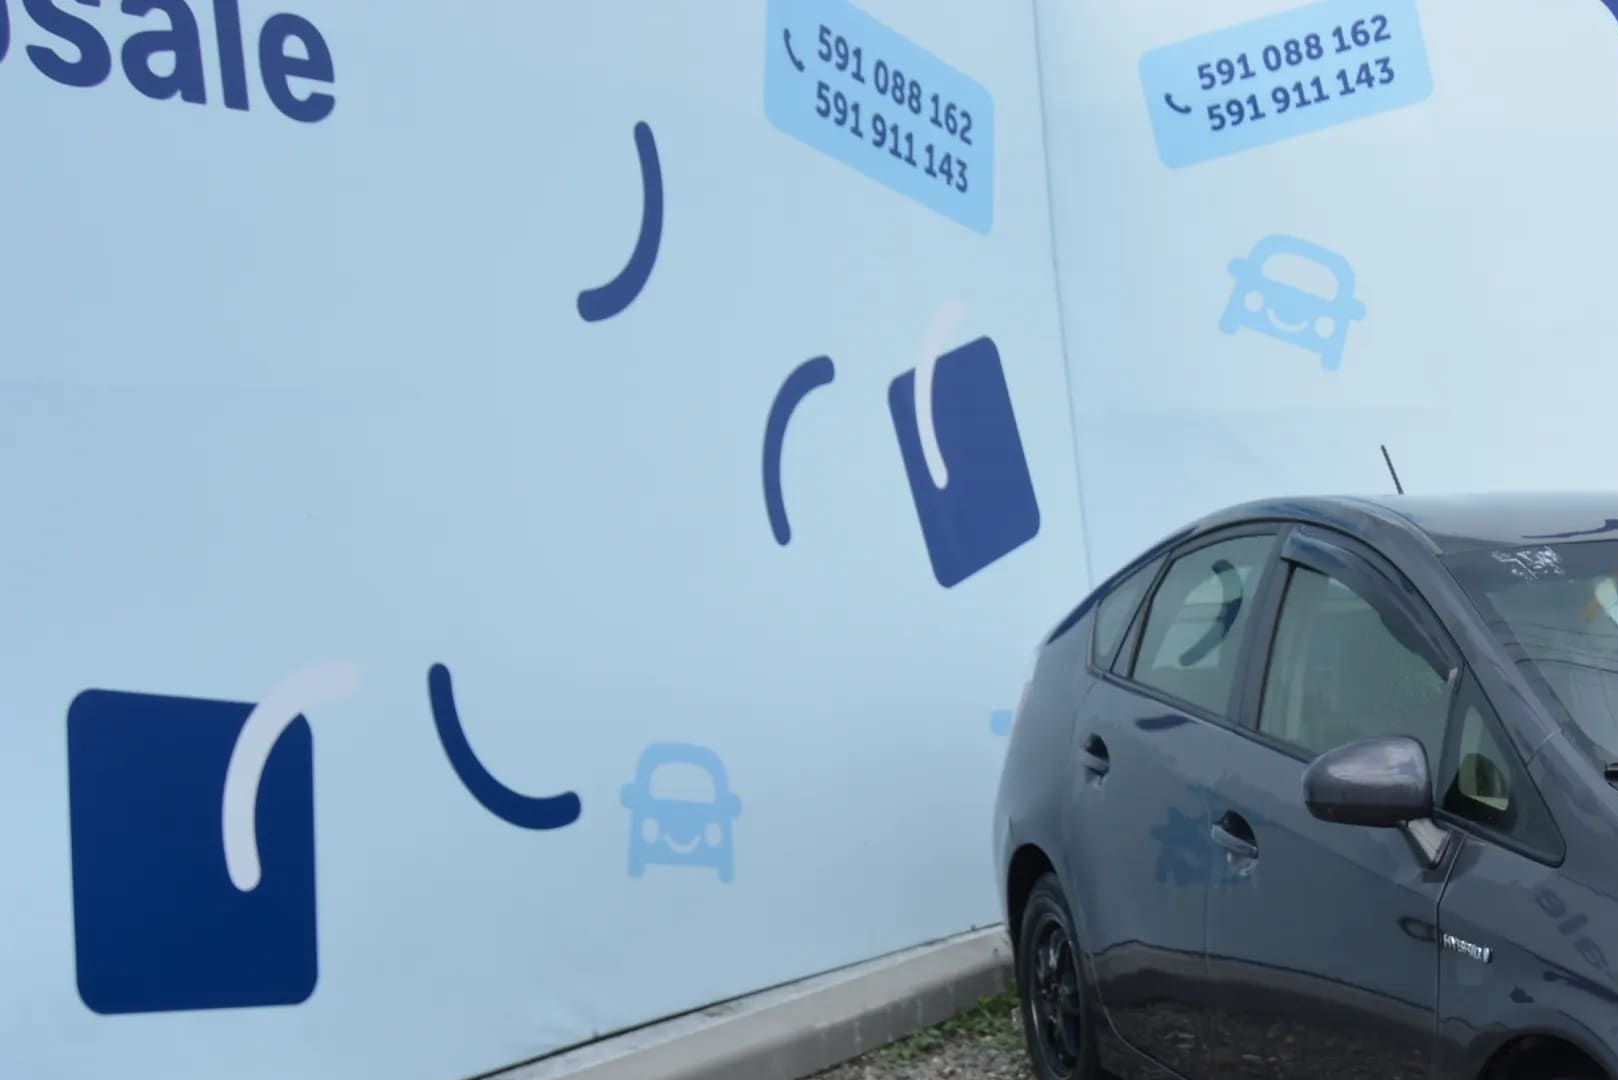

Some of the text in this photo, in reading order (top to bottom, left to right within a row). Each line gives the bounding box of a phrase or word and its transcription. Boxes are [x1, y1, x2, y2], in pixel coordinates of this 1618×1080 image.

[819, 27, 972, 145] 591 088 162
[1199, 16, 1391, 89] 591 088 162
[1208, 58, 1394, 131] 591 911 143
[816, 82, 967, 193] 591 911 143
